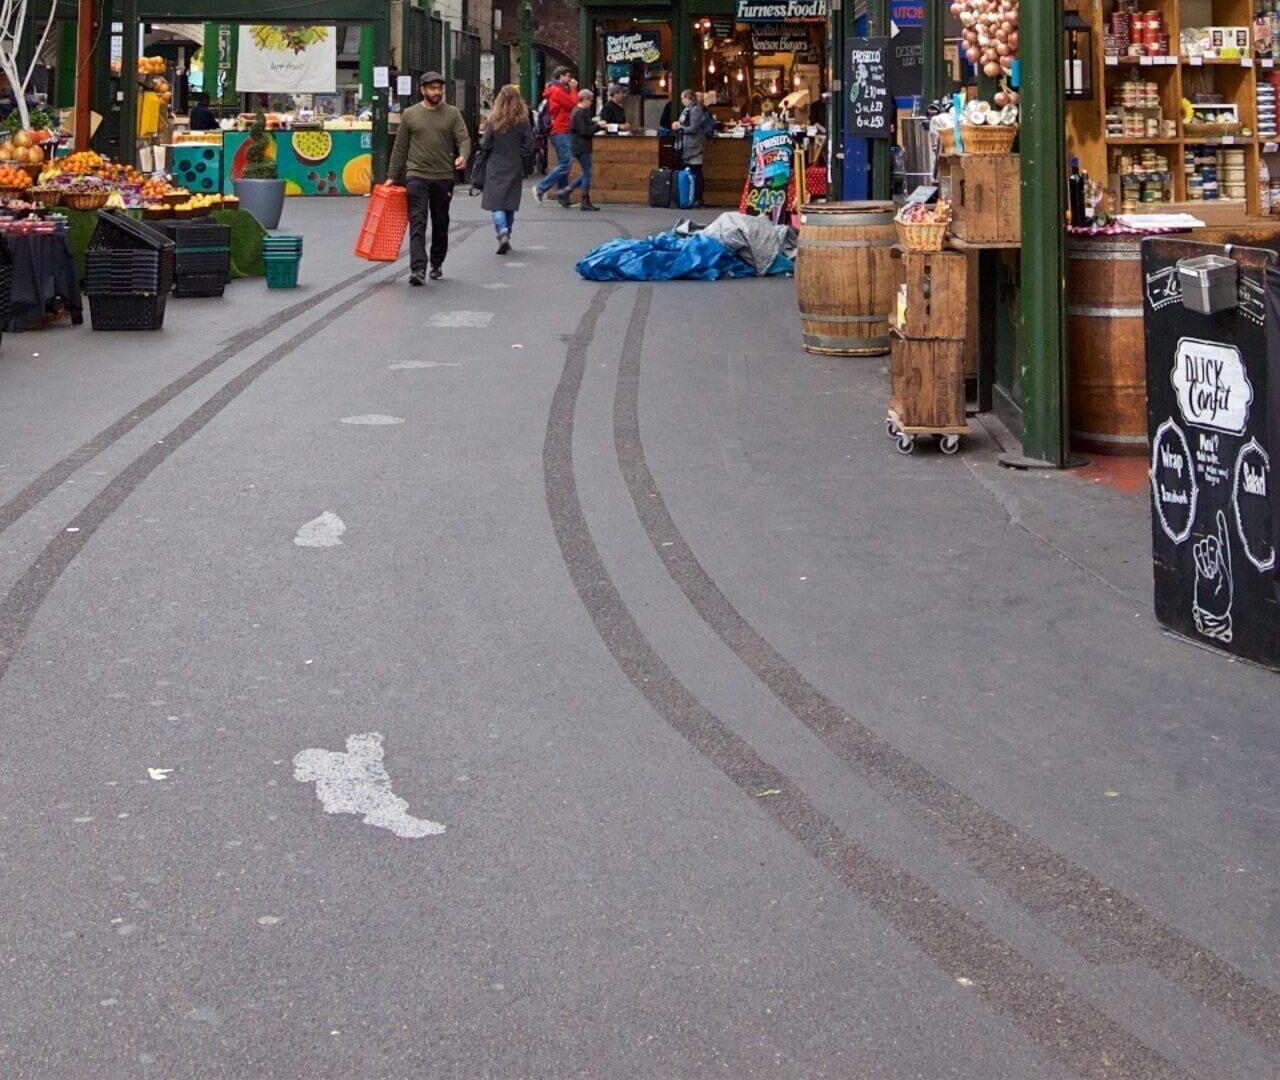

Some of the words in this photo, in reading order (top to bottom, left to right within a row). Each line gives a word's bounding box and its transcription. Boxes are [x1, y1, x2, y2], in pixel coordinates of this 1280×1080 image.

[737, 0, 786, 18] Furness
[787, 0, 818, 17] Food
[780, 37, 808, 51] Burgers
[1161, 443, 1184, 478] Wrap
[1242, 461, 1267, 497] Salad
